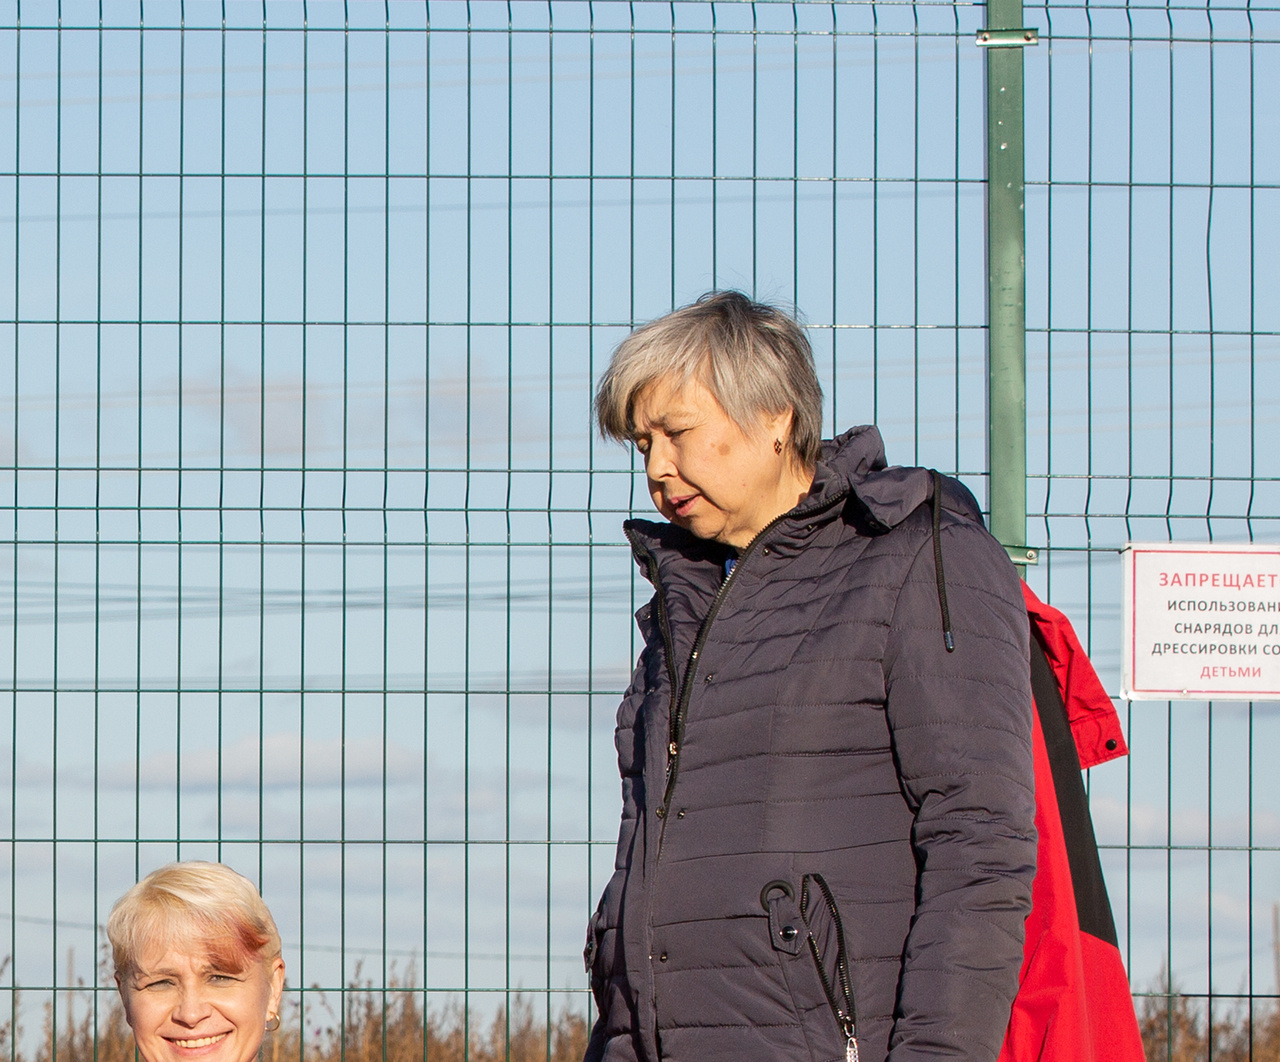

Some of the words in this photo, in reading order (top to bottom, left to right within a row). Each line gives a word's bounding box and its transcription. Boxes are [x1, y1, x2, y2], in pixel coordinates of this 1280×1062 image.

[1159, 572, 1280, 590] ЗАПРЕЩАЕТ
[1167, 600, 1280, 612] ИСПОЛЬЗОВАН
[1174, 623, 1253, 636] СНАРЯДОВ
[1257, 624, 1280, 637] ДЛ
[1151, 643, 1258, 656] ДРЕССИРОВКИ
[1200, 666, 1262, 680] ДЕТЬМИ
